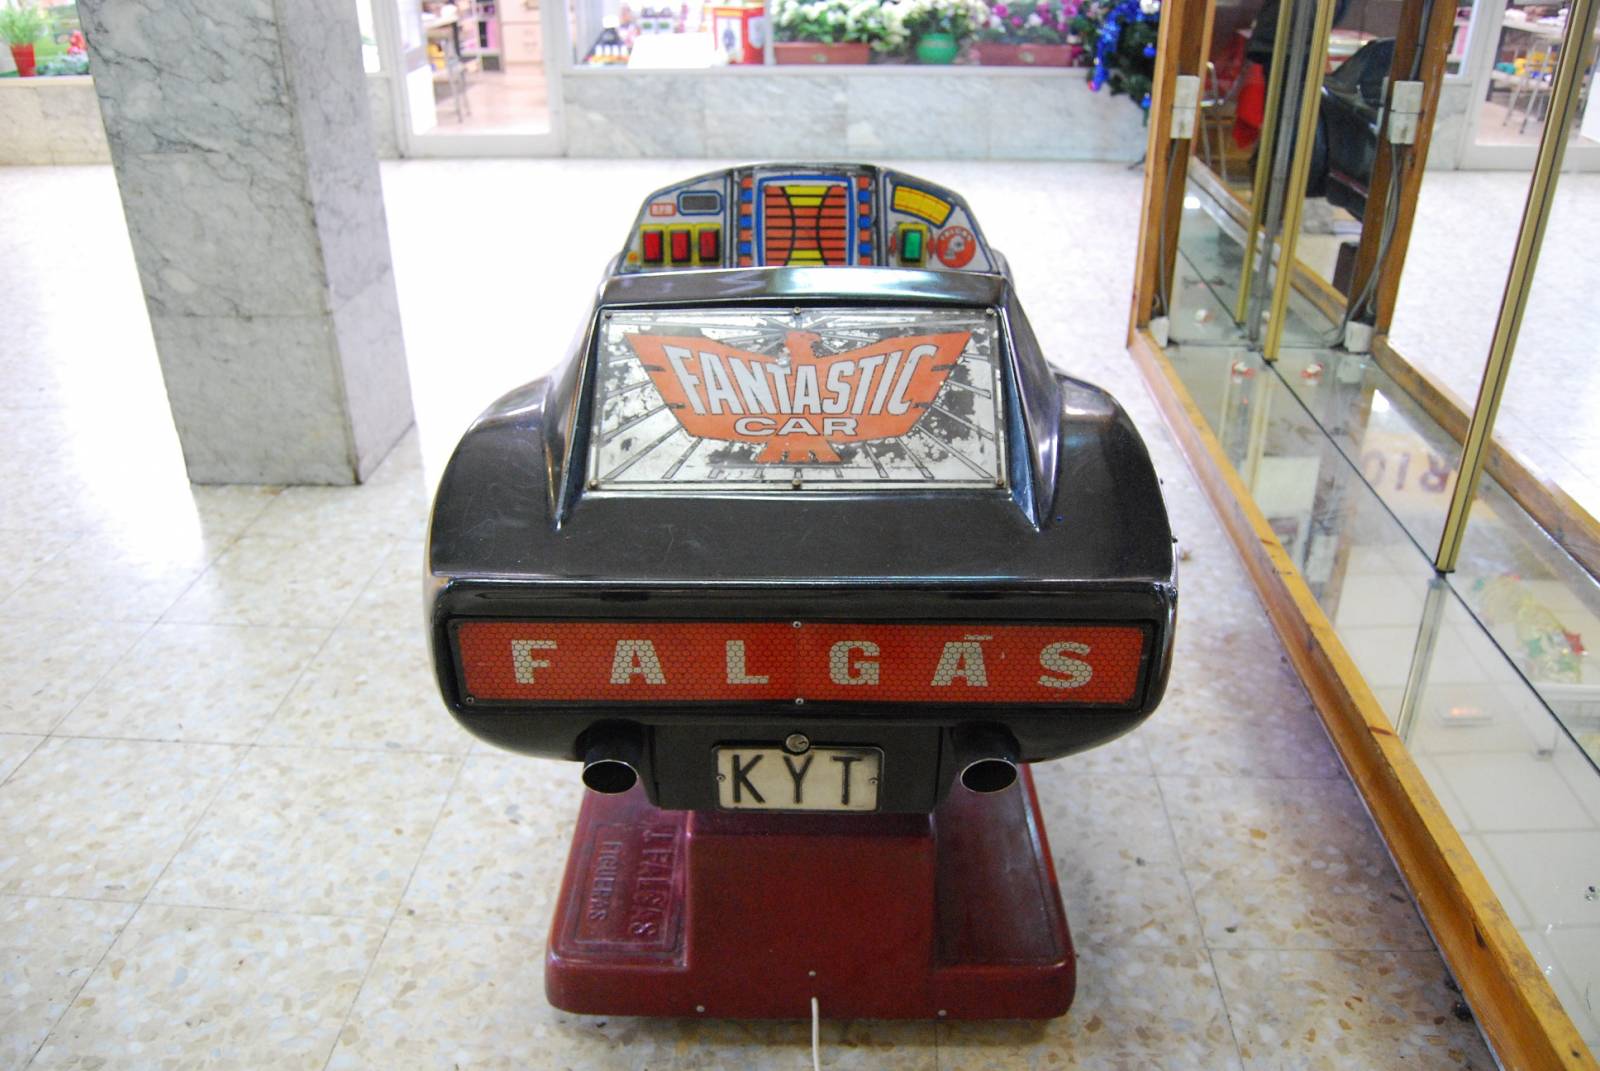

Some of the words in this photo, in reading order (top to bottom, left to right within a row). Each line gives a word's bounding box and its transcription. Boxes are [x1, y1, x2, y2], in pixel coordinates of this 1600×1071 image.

[662, 344, 937, 416] FANTASTIC
[734, 416, 858, 436] CAR
[731, 754, 864, 806] KYT
